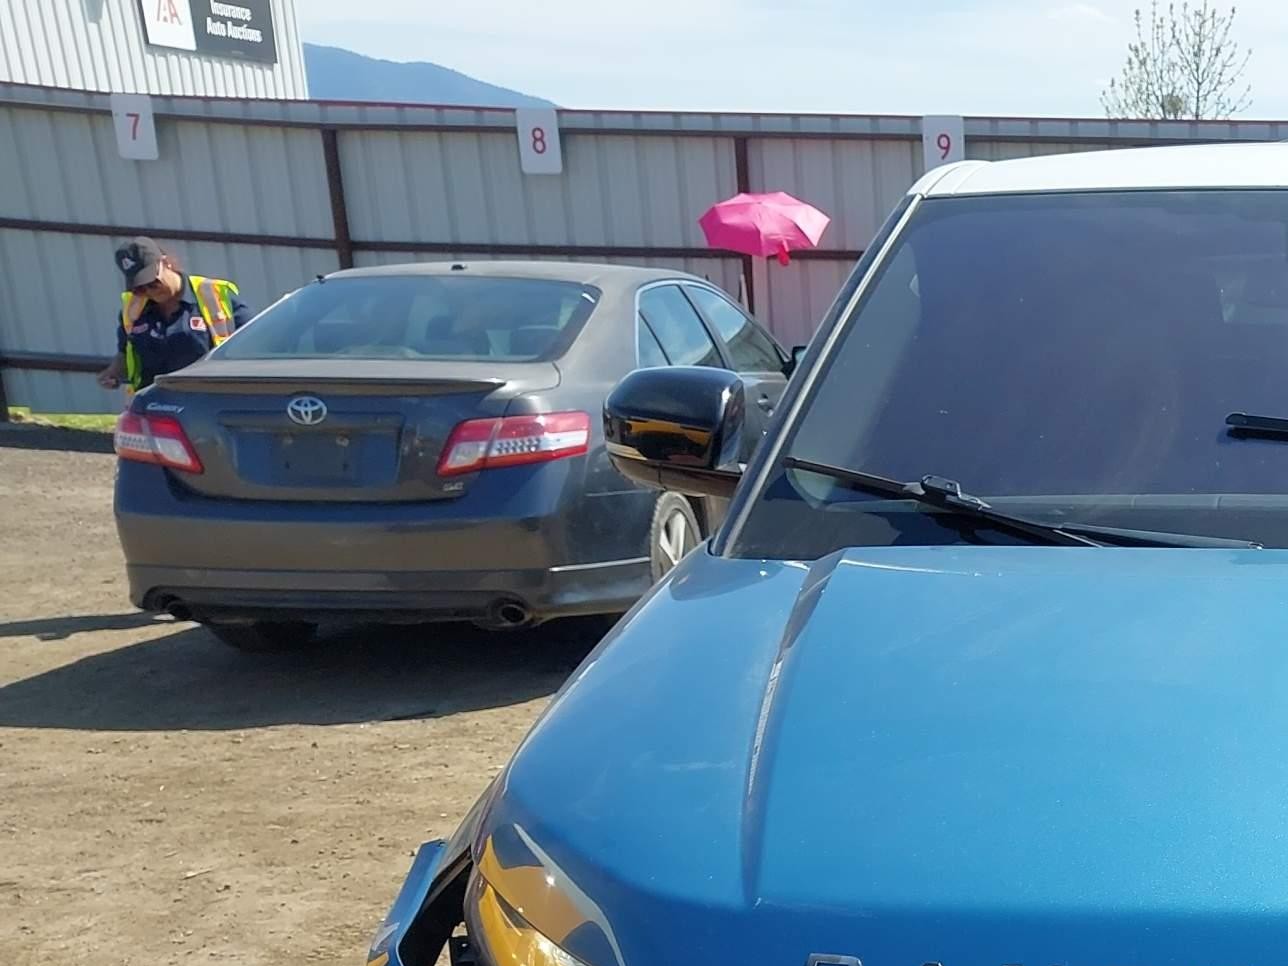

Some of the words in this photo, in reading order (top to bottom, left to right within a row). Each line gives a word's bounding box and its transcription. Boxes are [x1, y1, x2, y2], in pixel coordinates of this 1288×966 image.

[206, 17, 227, 37] Auto
[226, 21, 263, 43] Auctions
[125, 112, 140, 141] 7
[531, 127, 547, 155] 8
[937, 133, 951, 161] 9
